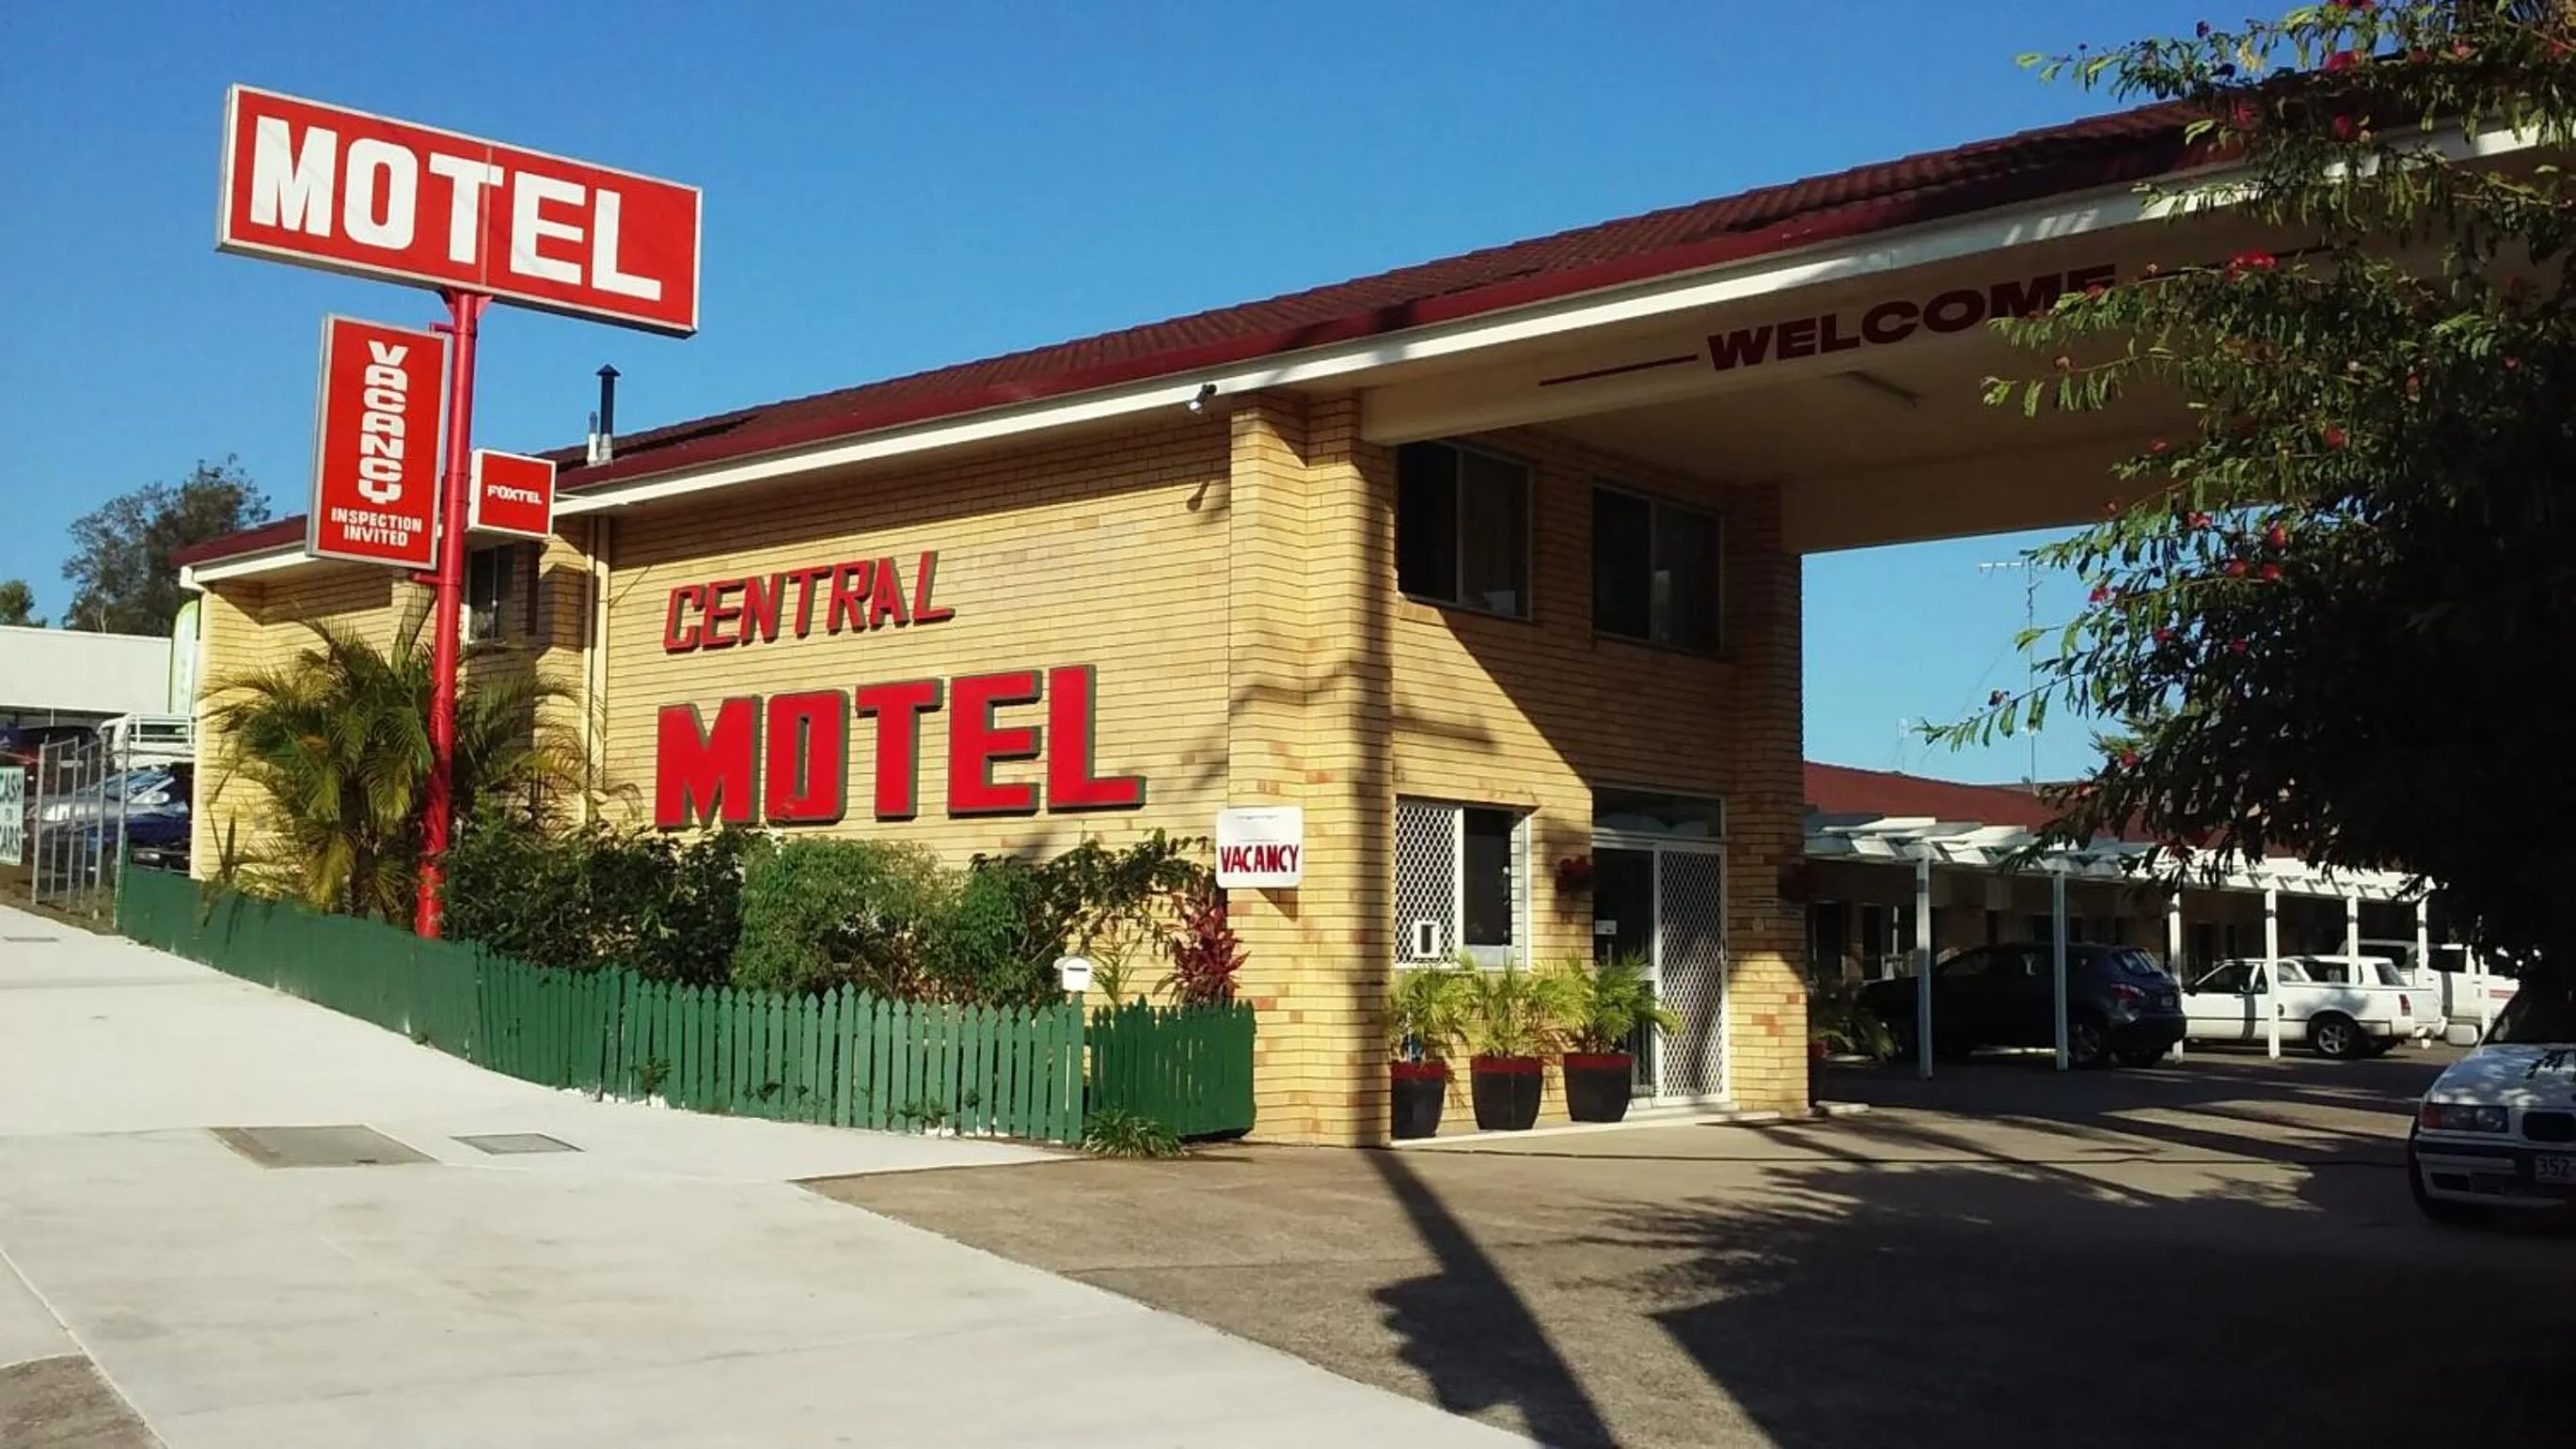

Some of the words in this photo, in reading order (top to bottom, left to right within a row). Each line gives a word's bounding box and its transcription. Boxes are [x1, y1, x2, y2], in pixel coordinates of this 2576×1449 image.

[250, 114, 661, 302] MOTEL
[357, 339, 409, 505] VACANCY
[331, 508, 422, 533] INSPECTION
[487, 484, 544, 505] FOXTEL
[343, 526, 408, 547] INVITED
[663, 550, 955, 654] CENTRAL
[656, 664, 1146, 831] MOTEL
[1220, 844, 1299, 874] VACANCY
